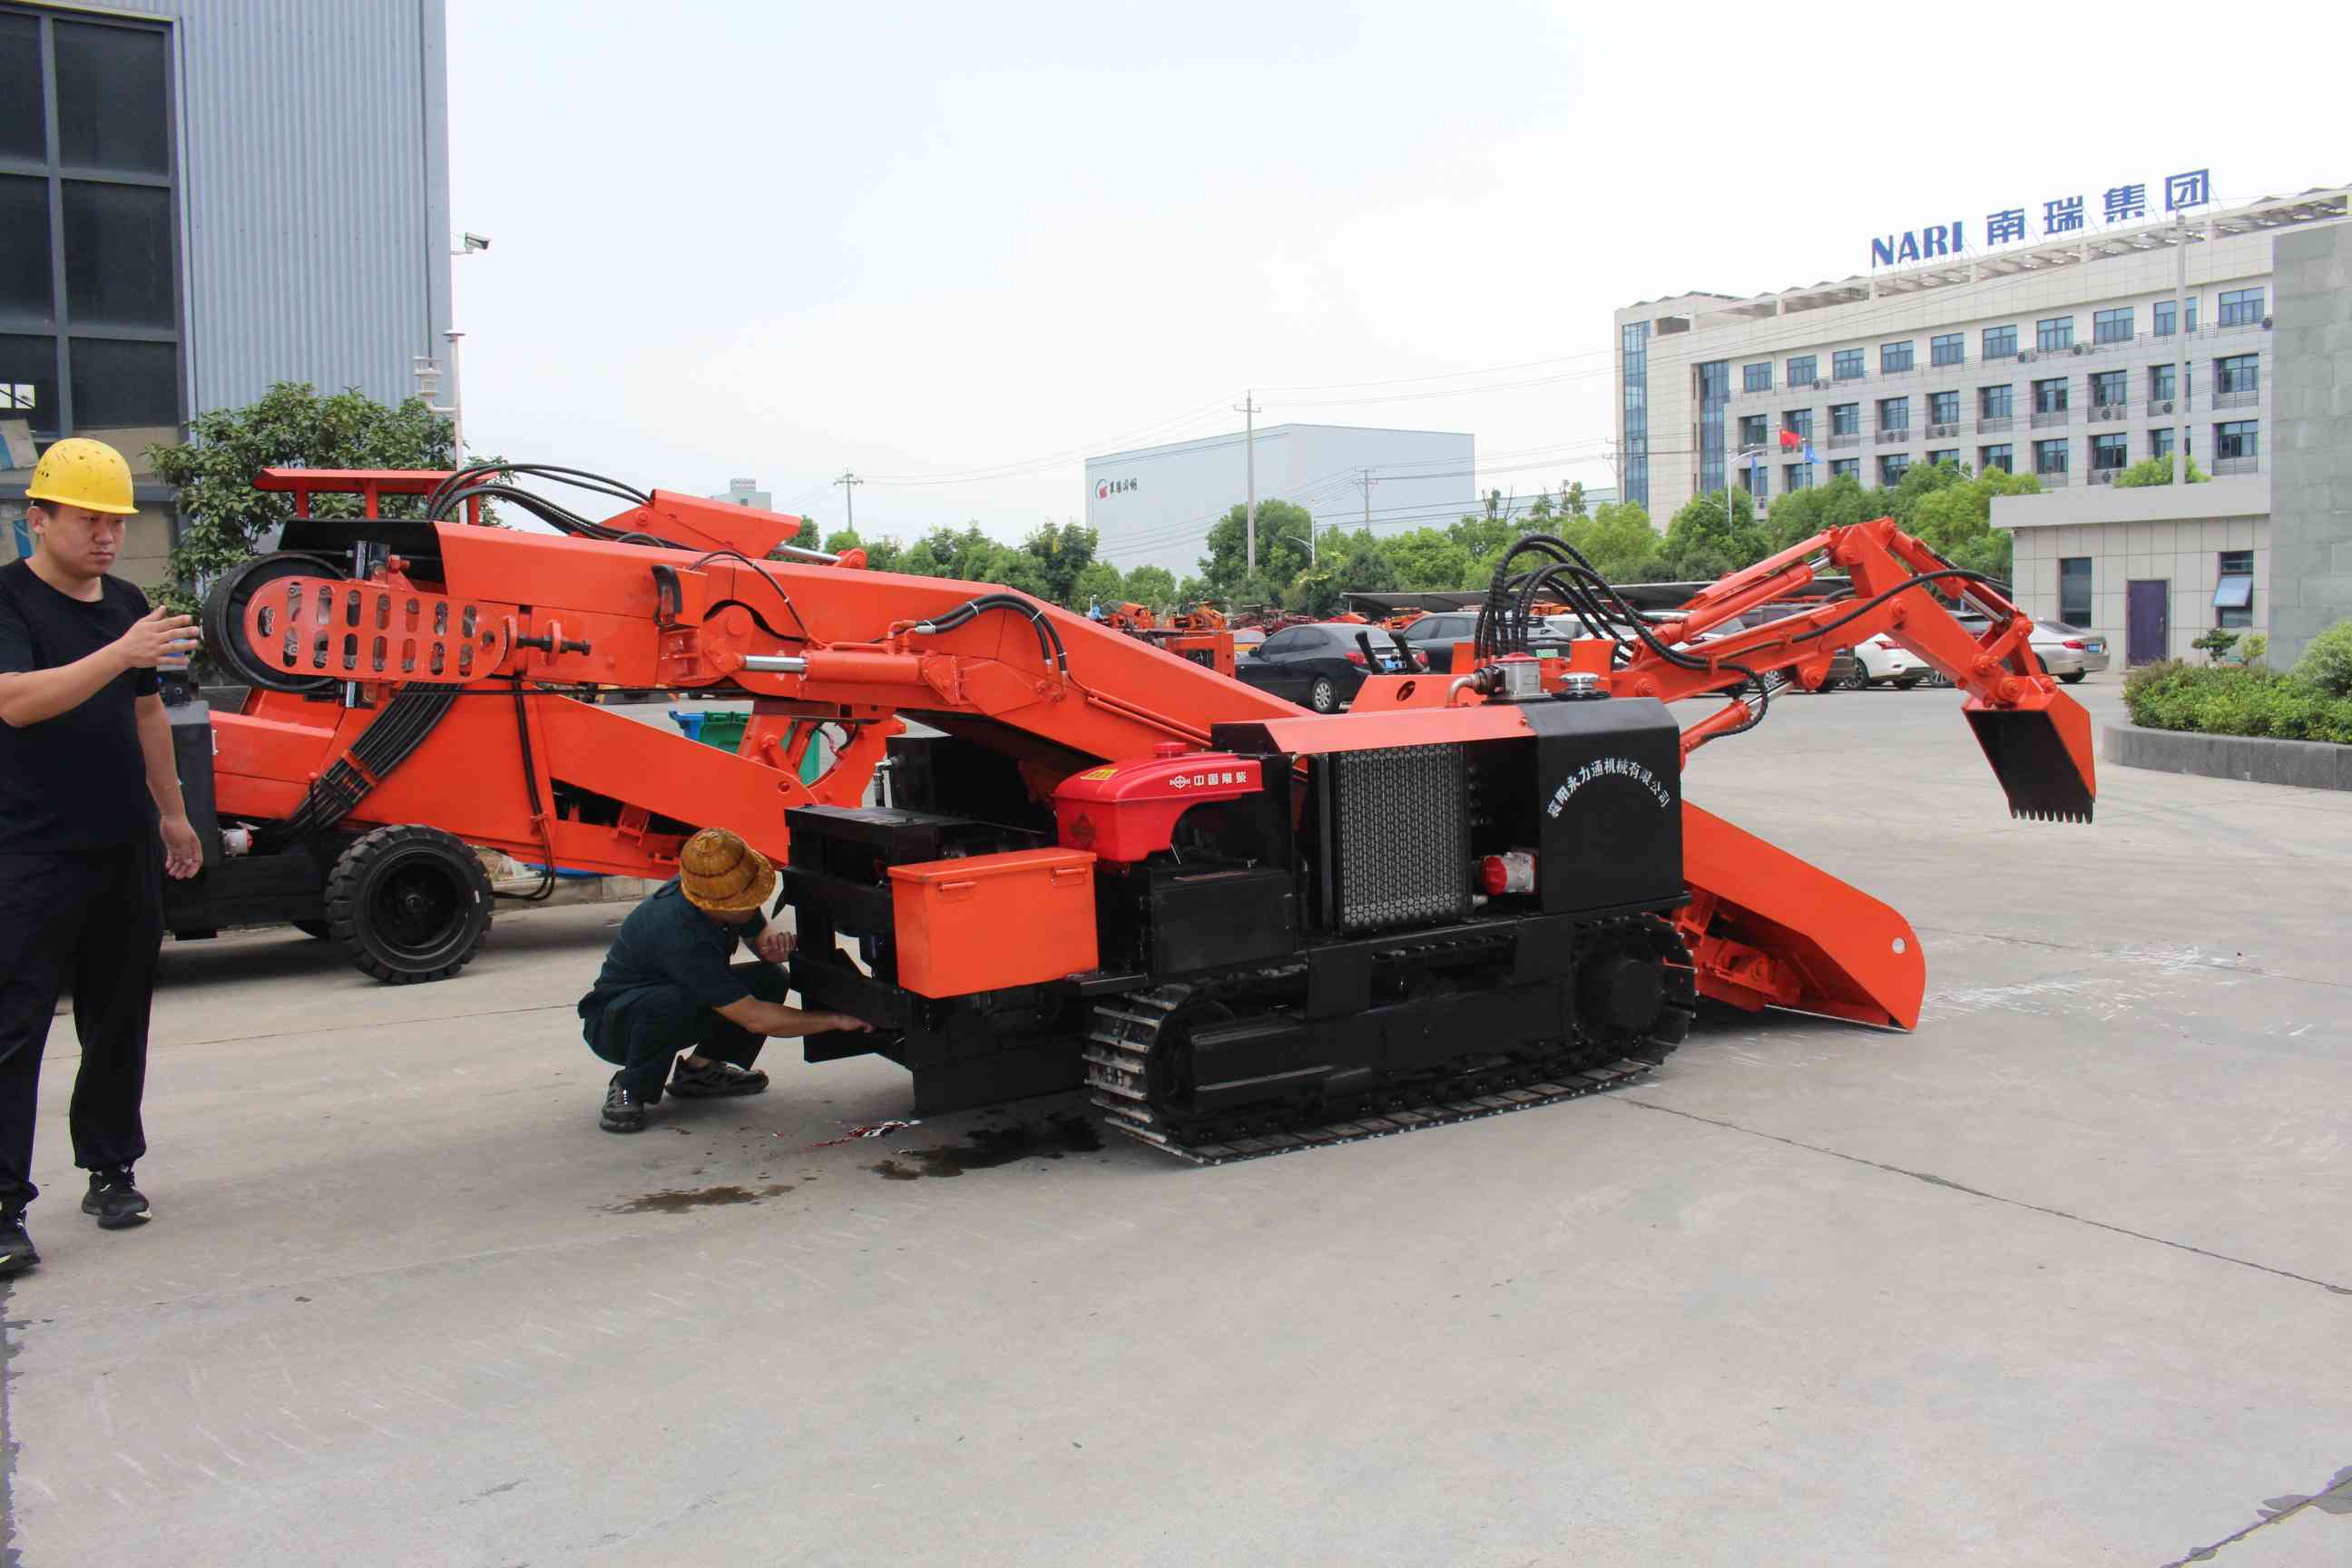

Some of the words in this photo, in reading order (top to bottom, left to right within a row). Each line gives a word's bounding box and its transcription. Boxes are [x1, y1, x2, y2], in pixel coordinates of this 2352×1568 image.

[1871, 220, 1963, 268] NARI
[1986, 168, 2209, 247] 南瑞集团
